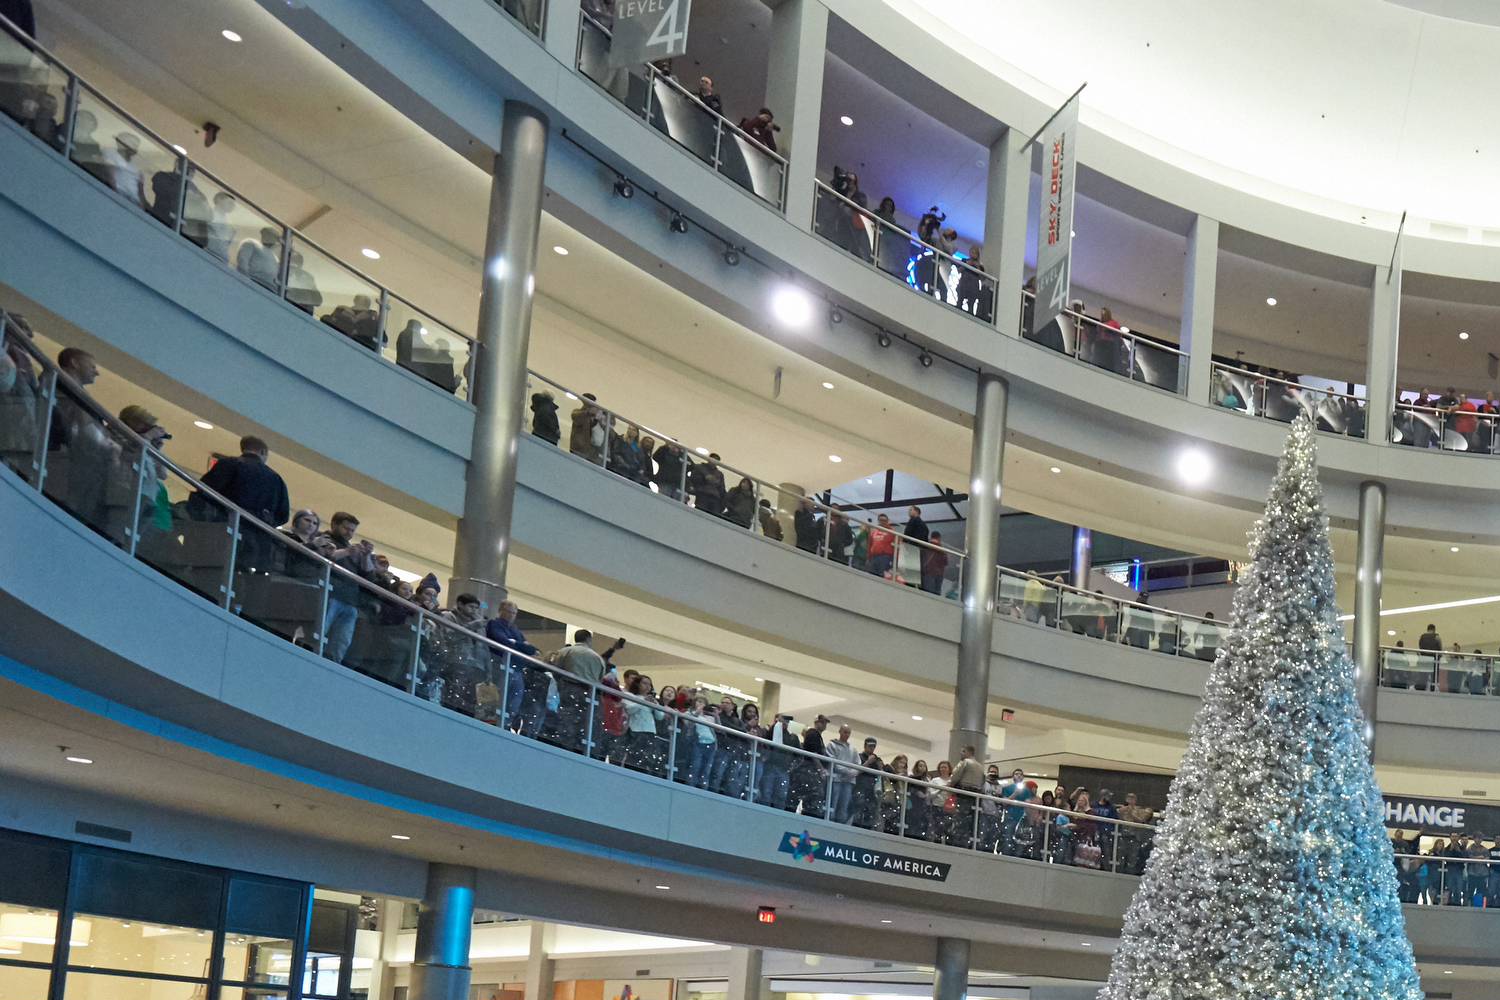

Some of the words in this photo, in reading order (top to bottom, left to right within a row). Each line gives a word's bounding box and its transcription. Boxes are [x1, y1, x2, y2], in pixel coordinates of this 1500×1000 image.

[618, 0, 665, 19] LEVEL
[645, 0, 683, 54] 4
[1050, 140, 1061, 194] DECK
[1048, 202, 1057, 245] SKY
[1036, 267, 1059, 294] LEVEL
[1049, 260, 1067, 310] 4
[824, 846, 858, 862] MALL
[862, 853, 880, 866] OF
[883, 857, 942, 878] AMERICA
